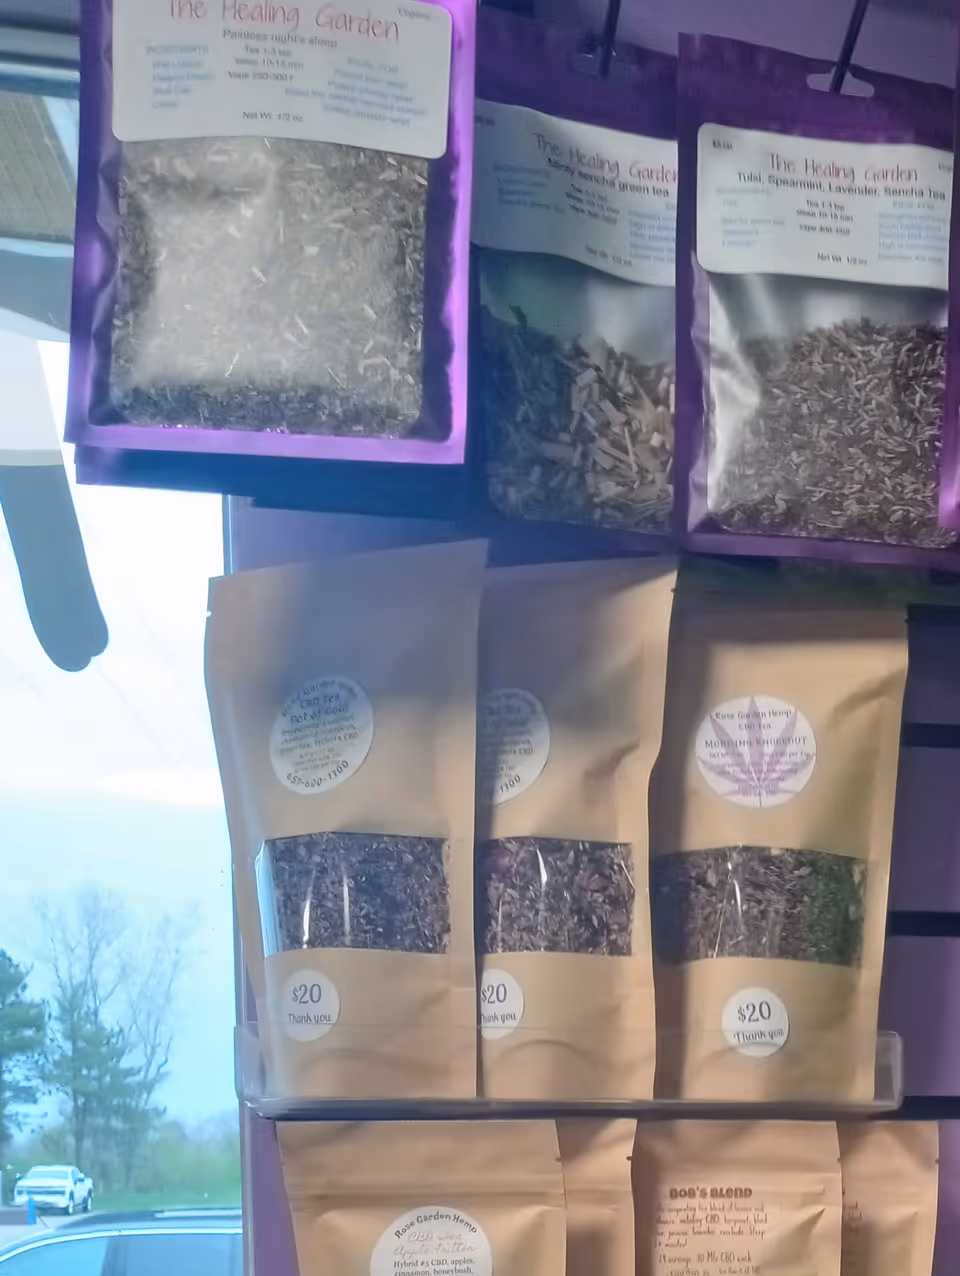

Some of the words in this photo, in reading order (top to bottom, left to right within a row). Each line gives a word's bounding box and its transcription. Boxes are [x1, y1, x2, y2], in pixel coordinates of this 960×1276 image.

[222, 0, 299, 32] Healing
[315, 3, 399, 43] Garden
[222, 29, 269, 43] Painless
[532, 132, 561, 156] The
[569, 146, 620, 180] Healing
[768, 153, 796, 175] The
[804, 158, 856, 181] Healing
[864, 164, 919, 184] Garden
[292, 984, 322, 1004] $20
[481, 983, 507, 1004] $20
[288, 1013, 312, 1024] Thank
[314, 1013, 333, 1024] you
[480, 1012, 499, 1024] hank
[500, 1013, 517, 1024] you
[737, 1000, 771, 1024] $20
[733, 1030, 767, 1044] Thank
[669, 1186, 708, 1200] BOB'S
[710, 1186, 753, 1199] BLEND
[394, 1220, 416, 1239] Rose
[416, 1211, 451, 1224] Garden
[452, 1213, 478, 1234] Hemp
[393, 1260, 419, 1269] Hybrid
[420, 1260, 430, 1268] #5
[431, 1258, 449, 1267] CBD,
[451, 1257, 475, 1266] apples,
[433, 1266, 474, 1276] honeybush,
